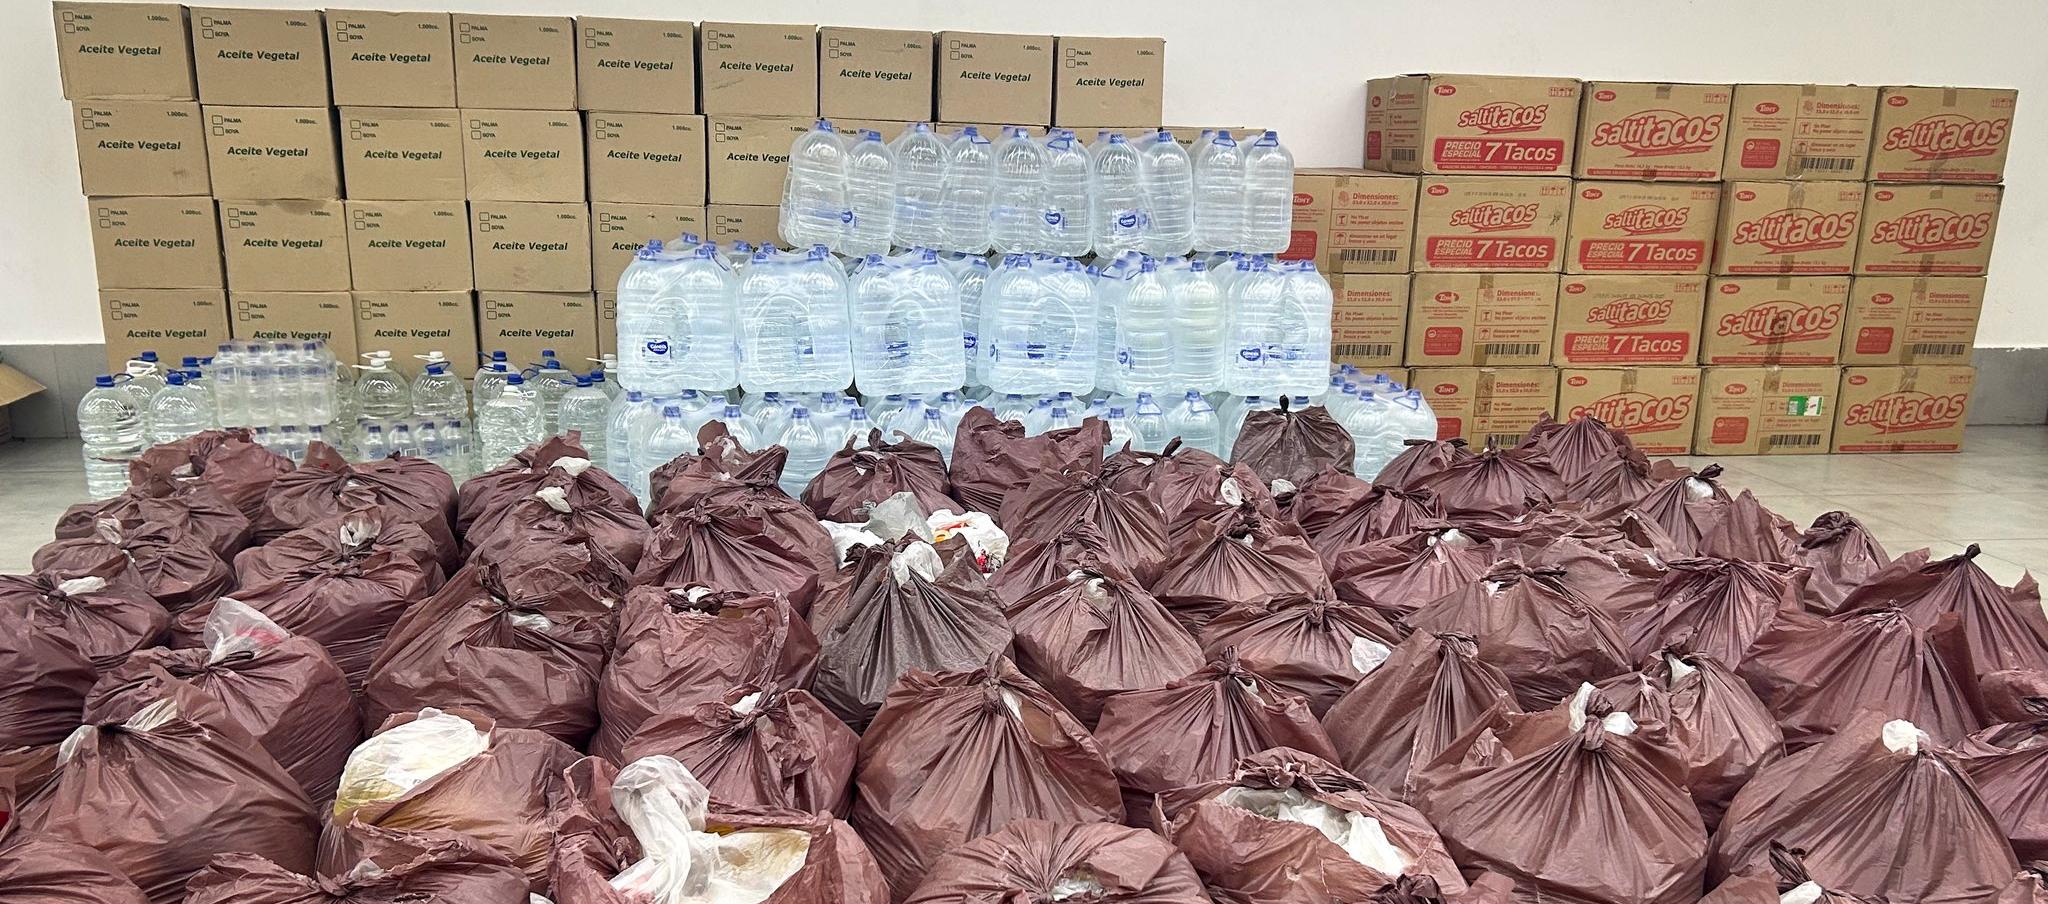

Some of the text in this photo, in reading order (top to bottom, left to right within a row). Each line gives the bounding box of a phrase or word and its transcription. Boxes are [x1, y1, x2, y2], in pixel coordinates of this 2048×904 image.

[78, 44, 161, 57] Aceite Vegetal
[217, 49, 300, 62] Aceite Vegetal
[351, 52, 431, 64] Aceite Vegetal
[472, 54, 550, 66] Aceite Vegetal
[597, 59, 674, 71] Aceite Vegetal
[719, 61, 794, 73] Aceite Vegetal
[839, 69, 912, 81] Aceite Vegetal
[959, 70, 1031, 83] Aceite Vegetal
[1075, 77, 1145, 88] Aceite Vegetal
[1458, 104, 1548, 128] Saltitacos
[1591, 114, 1724, 148] Saltitacos
[1883, 119, 2009, 151] Saltitacos
[97, 140, 181, 152] Aceite Vegetal
[1445, 141, 1481, 149] PRECIO
[227, 146, 308, 158] Aceite Vegetal
[364, 150, 442, 161] Aceite Vegetal
[484, 149, 560, 160] Aceite Vegetal
[607, 150, 682, 163] Aceite Vegetal
[1485, 142, 1556, 161] 7 Tacos
[726, 152, 790, 164] Aceite Veget
[1450, 202, 1539, 226] Saltitacos
[1603, 207, 1690, 229] Saltitacos
[1733, 211, 1858, 245] Saltitacos
[1871, 211, 1993, 244] Saltitacos
[114, 238, 195, 249] Aceite Vegetal
[243, 238, 323, 249] Aceite Vegetal
[368, 239, 446, 250] Aceite Vegetal
[492, 241, 568, 252] Aceite Vegetal
[611, 242, 644, 251] Aceite
[1477, 240, 1548, 258] 7 Tacos
[1628, 243, 1697, 261] 7 Tacos
[1587, 299, 1673, 323] Saltitacos
[1717, 303, 1842, 336] Saltitacos
[126, 329, 207, 340] Aceite Vegetal
[252, 330, 332, 341] Aceite Vegetal
[374, 329, 451, 339] Aceite Vegetal
[499, 329, 574, 339] Aceite Vegetal
[1613, 336, 1682, 353] 7 Tacos
